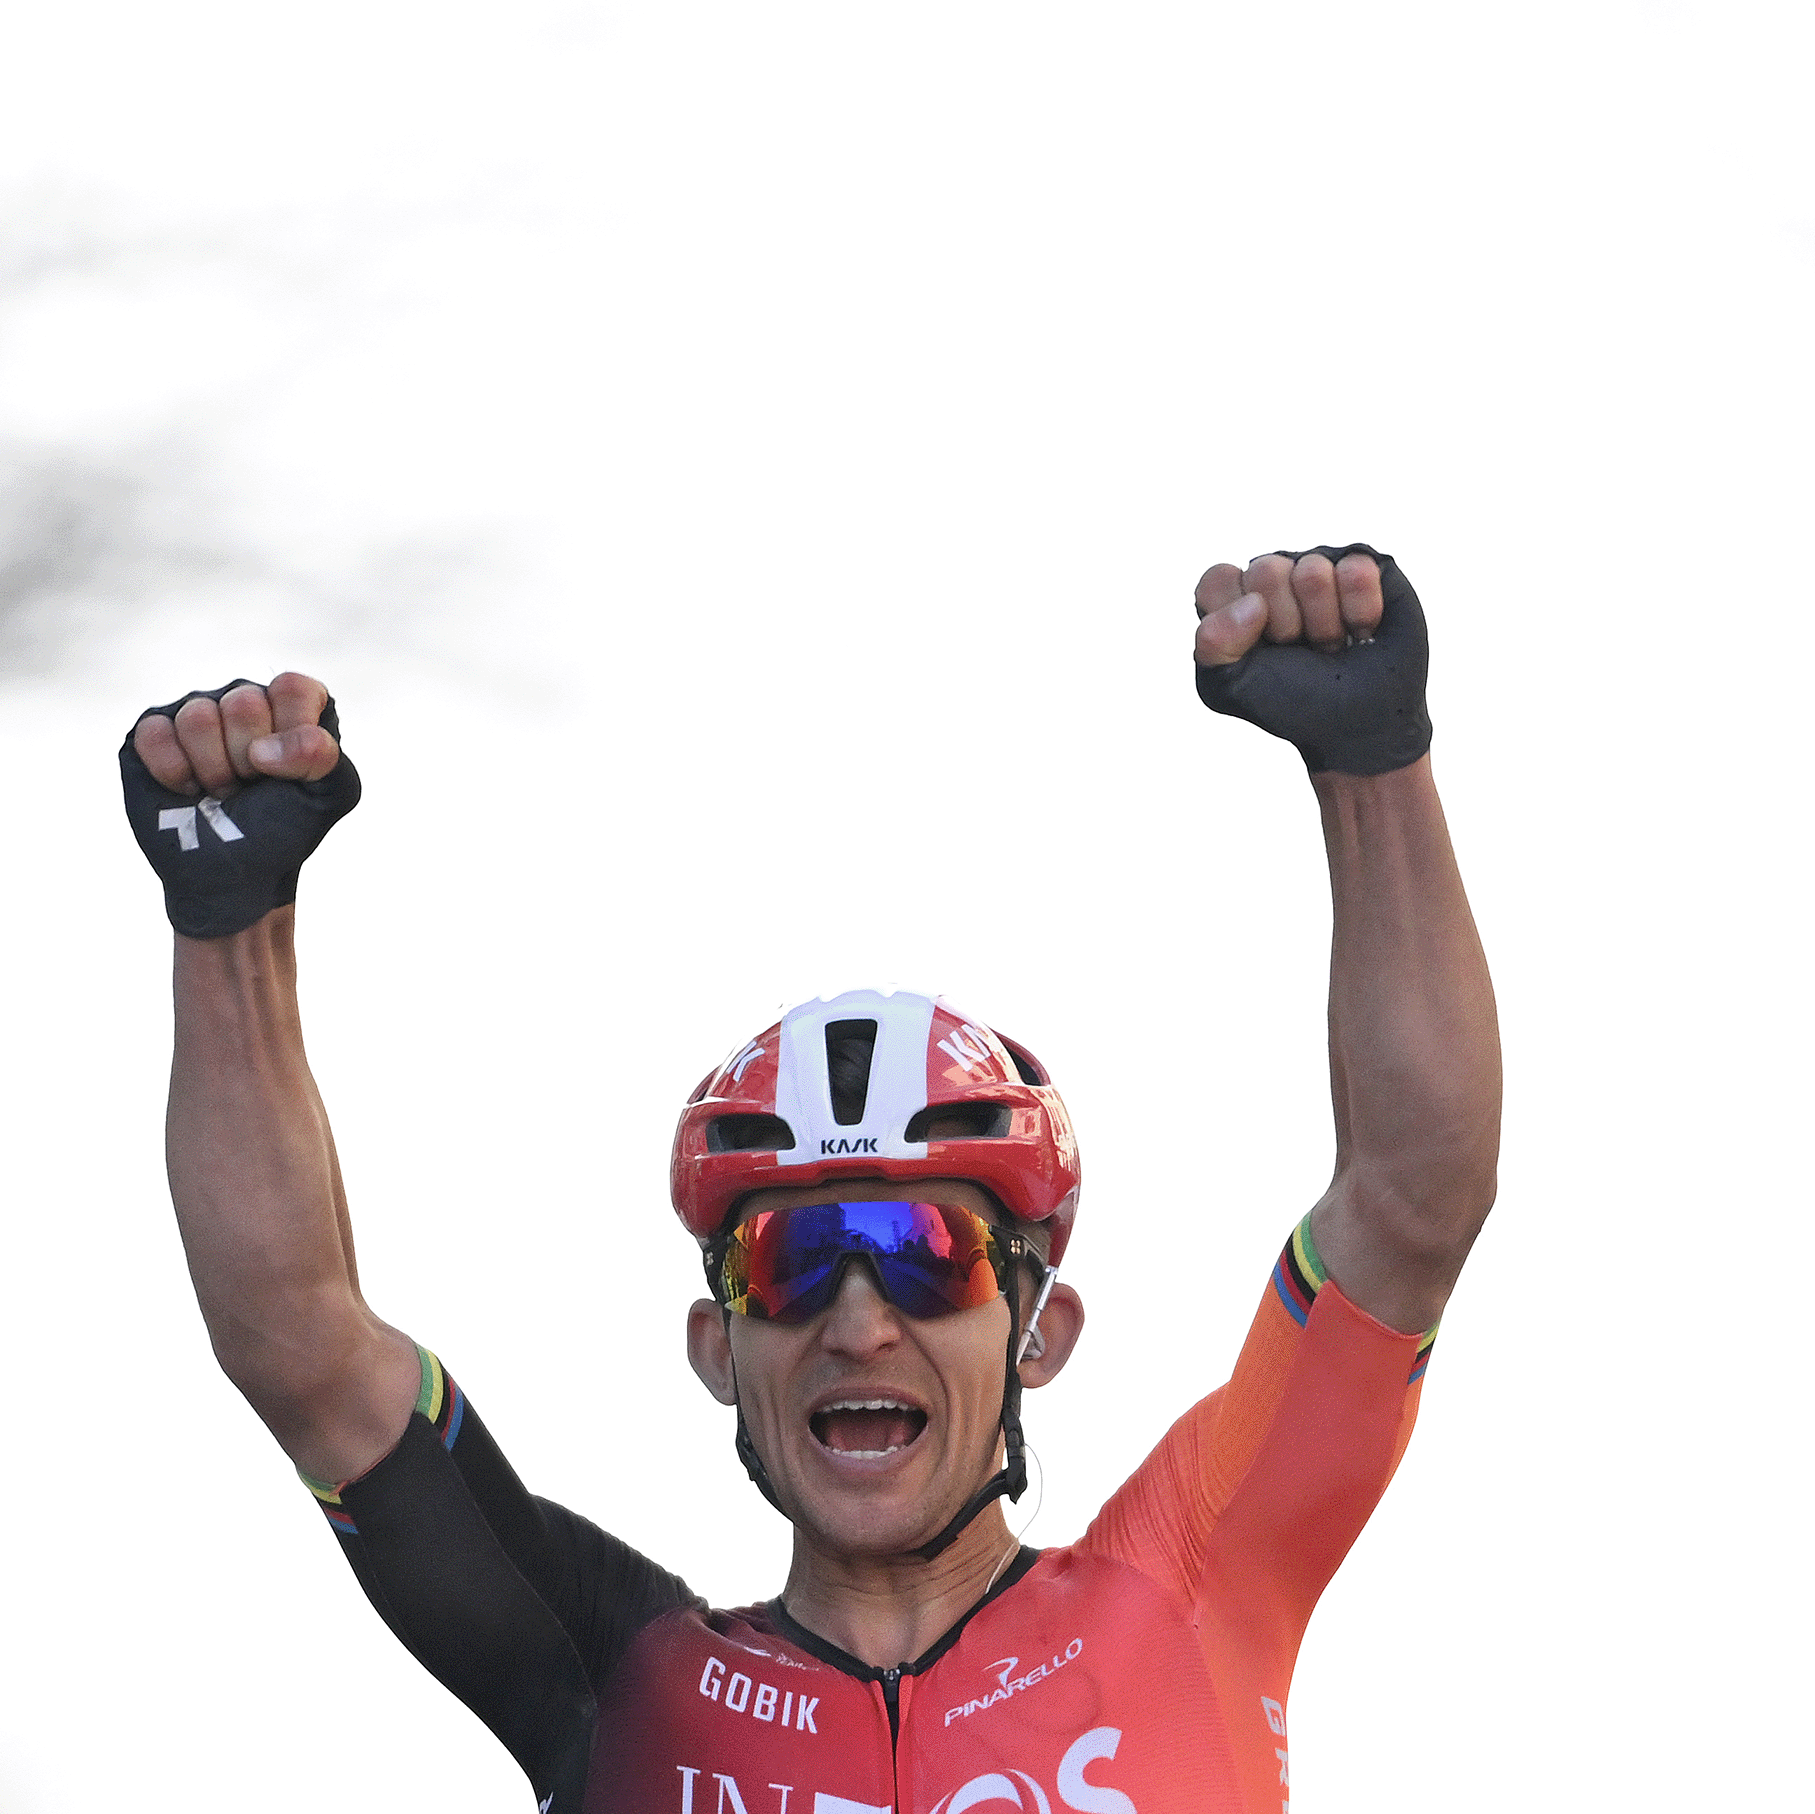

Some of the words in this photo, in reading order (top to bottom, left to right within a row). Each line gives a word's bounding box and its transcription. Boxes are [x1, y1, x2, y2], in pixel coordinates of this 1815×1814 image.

[820, 1137, 879, 1155] KASK
[699, 1656, 820, 1734] GOBIK
[944, 1637, 1084, 1728] PINARELLO
